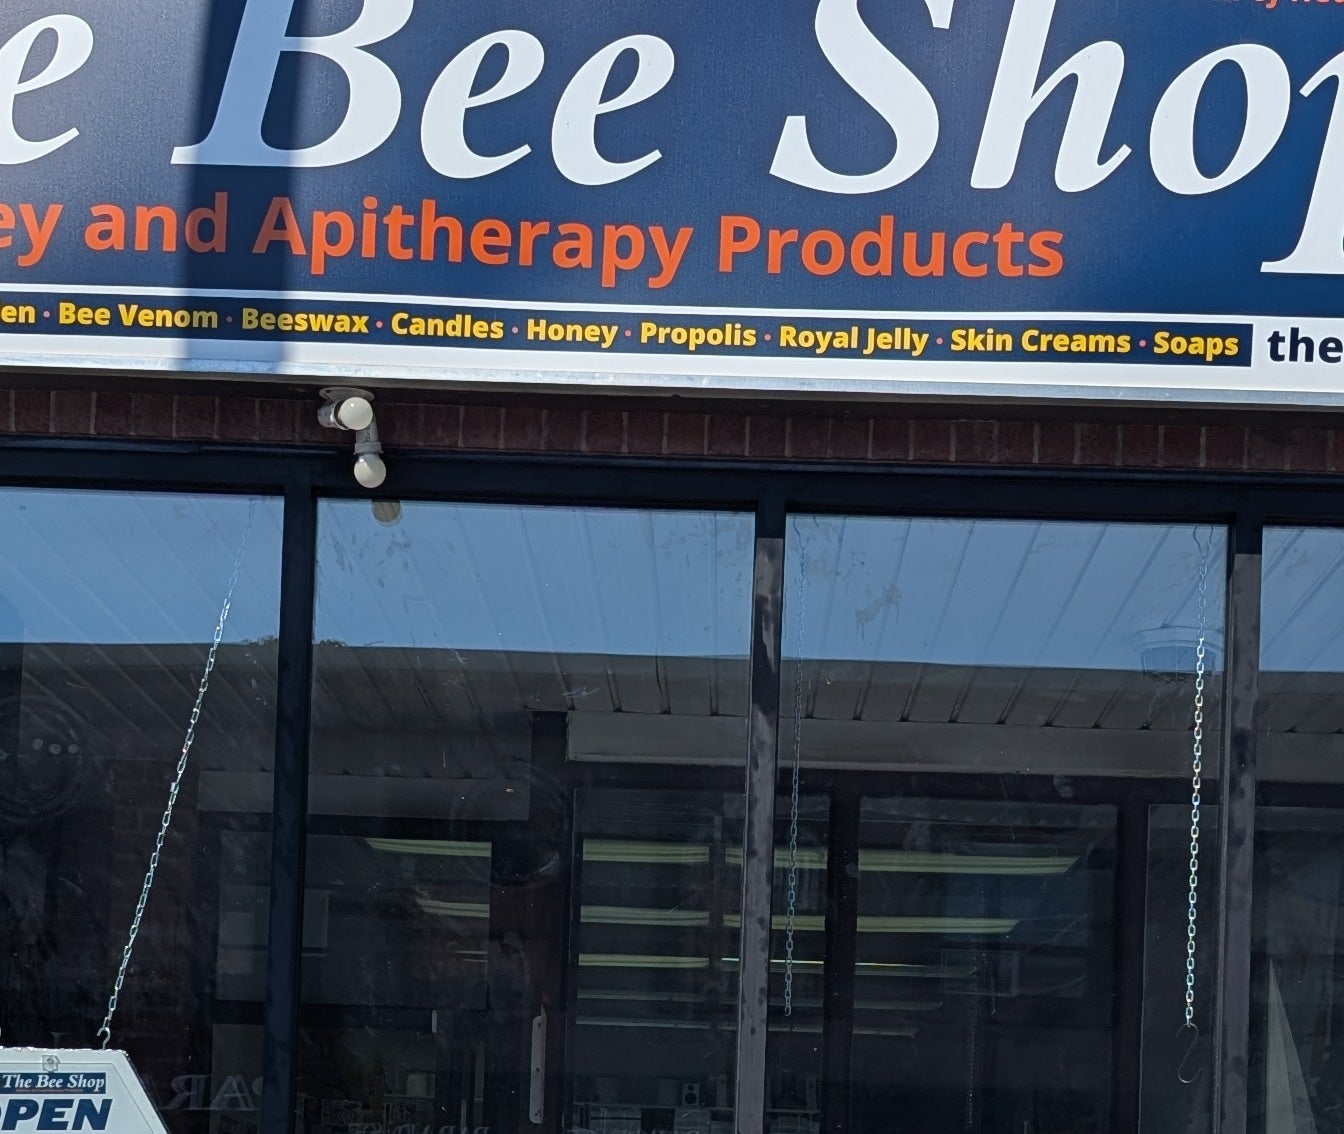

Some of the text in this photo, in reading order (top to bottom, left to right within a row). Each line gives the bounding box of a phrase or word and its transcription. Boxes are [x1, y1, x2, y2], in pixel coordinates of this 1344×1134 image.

[170, 0, 674, 185] Bee
[84, 188, 230, 252] and
[252, 192, 692, 287] Apitherapy
[720, 216, 1062, 276] Products
[59, 302, 110, 324] Bee
[119, 305, 220, 328] Venom
[242, 307, 368, 333] Beeswax
[392, 313, 503, 339] Candles
[527, 320, 616, 347] Honey
[640, 322, 756, 350] Propolis
[780, 325, 858, 352] Royal
[857, 328, 927, 355] Jelly
[952, 329, 1012, 351] Skin
[1020, 329, 1131, 353] Creams
[1154, 332, 1238, 360] Soaps
[3, 1074, 104, 1091] The Bee Shop
